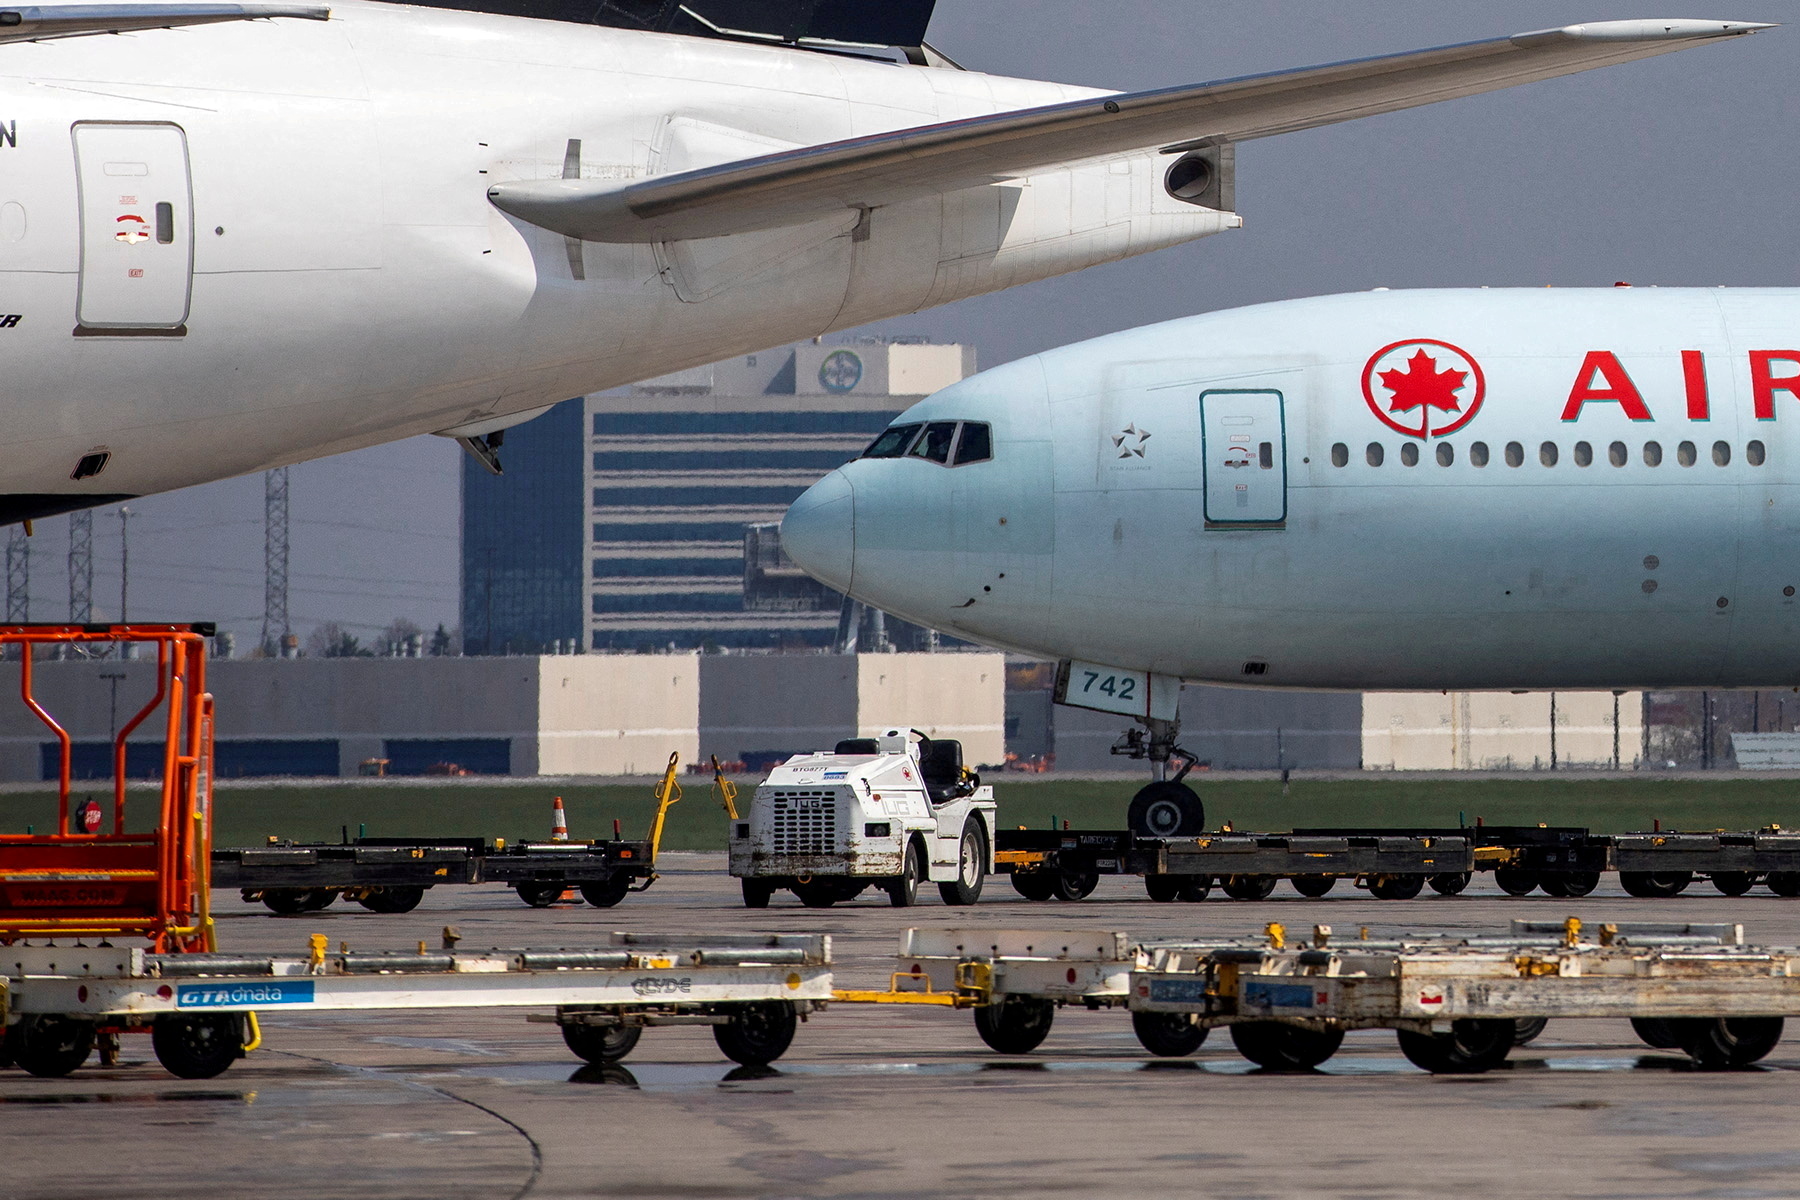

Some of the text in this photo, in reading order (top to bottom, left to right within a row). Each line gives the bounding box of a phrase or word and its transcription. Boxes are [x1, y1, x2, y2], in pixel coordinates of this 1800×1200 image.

[1083, 671, 1136, 700] 742
[789, 797, 820, 808] TUG
[881, 793, 911, 816] TUG
[181, 985, 282, 1004] GTA dnata
[631, 977, 691, 995] CLYDE
